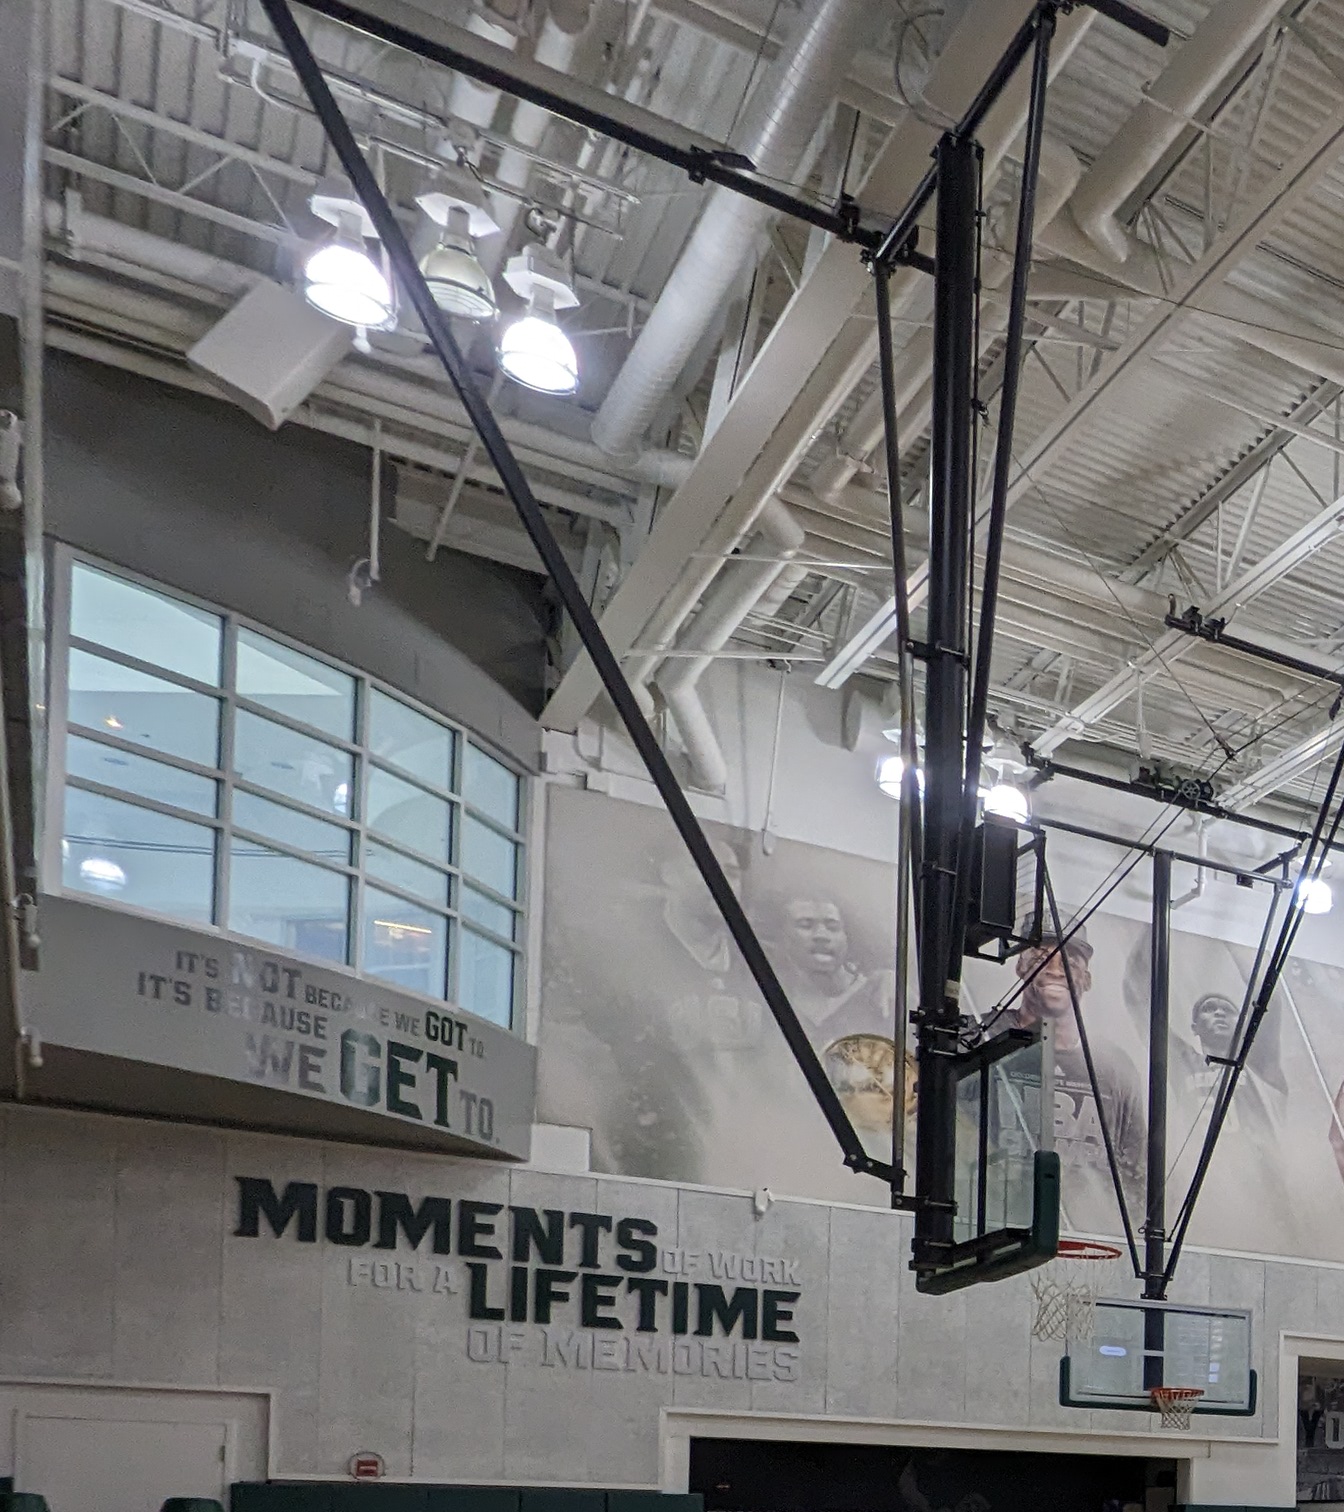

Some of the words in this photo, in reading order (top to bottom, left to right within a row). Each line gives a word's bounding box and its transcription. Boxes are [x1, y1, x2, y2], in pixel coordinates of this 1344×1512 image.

[137, 972, 192, 1006] IT'S
[175, 951, 220, 978] IT'S
[231, 953, 302, 999] NOT
[394, 1012, 420, 1037] WE
[425, 1010, 468, 1051] GOT
[246, 1032, 327, 1094] WE
[340, 1028, 459, 1128] GET
[234, 1176, 658, 1273] MOMENTS
[661, 1249, 702, 1277] OF
[708, 1251, 802, 1286] WORK
[347, 1256, 423, 1293] FOR
[433, 1269, 457, 1296] A
[466, 1262, 802, 1342] LIFETIME
[467, 1326, 525, 1366] OF
[540, 1330, 799, 1383] MEMORIES
